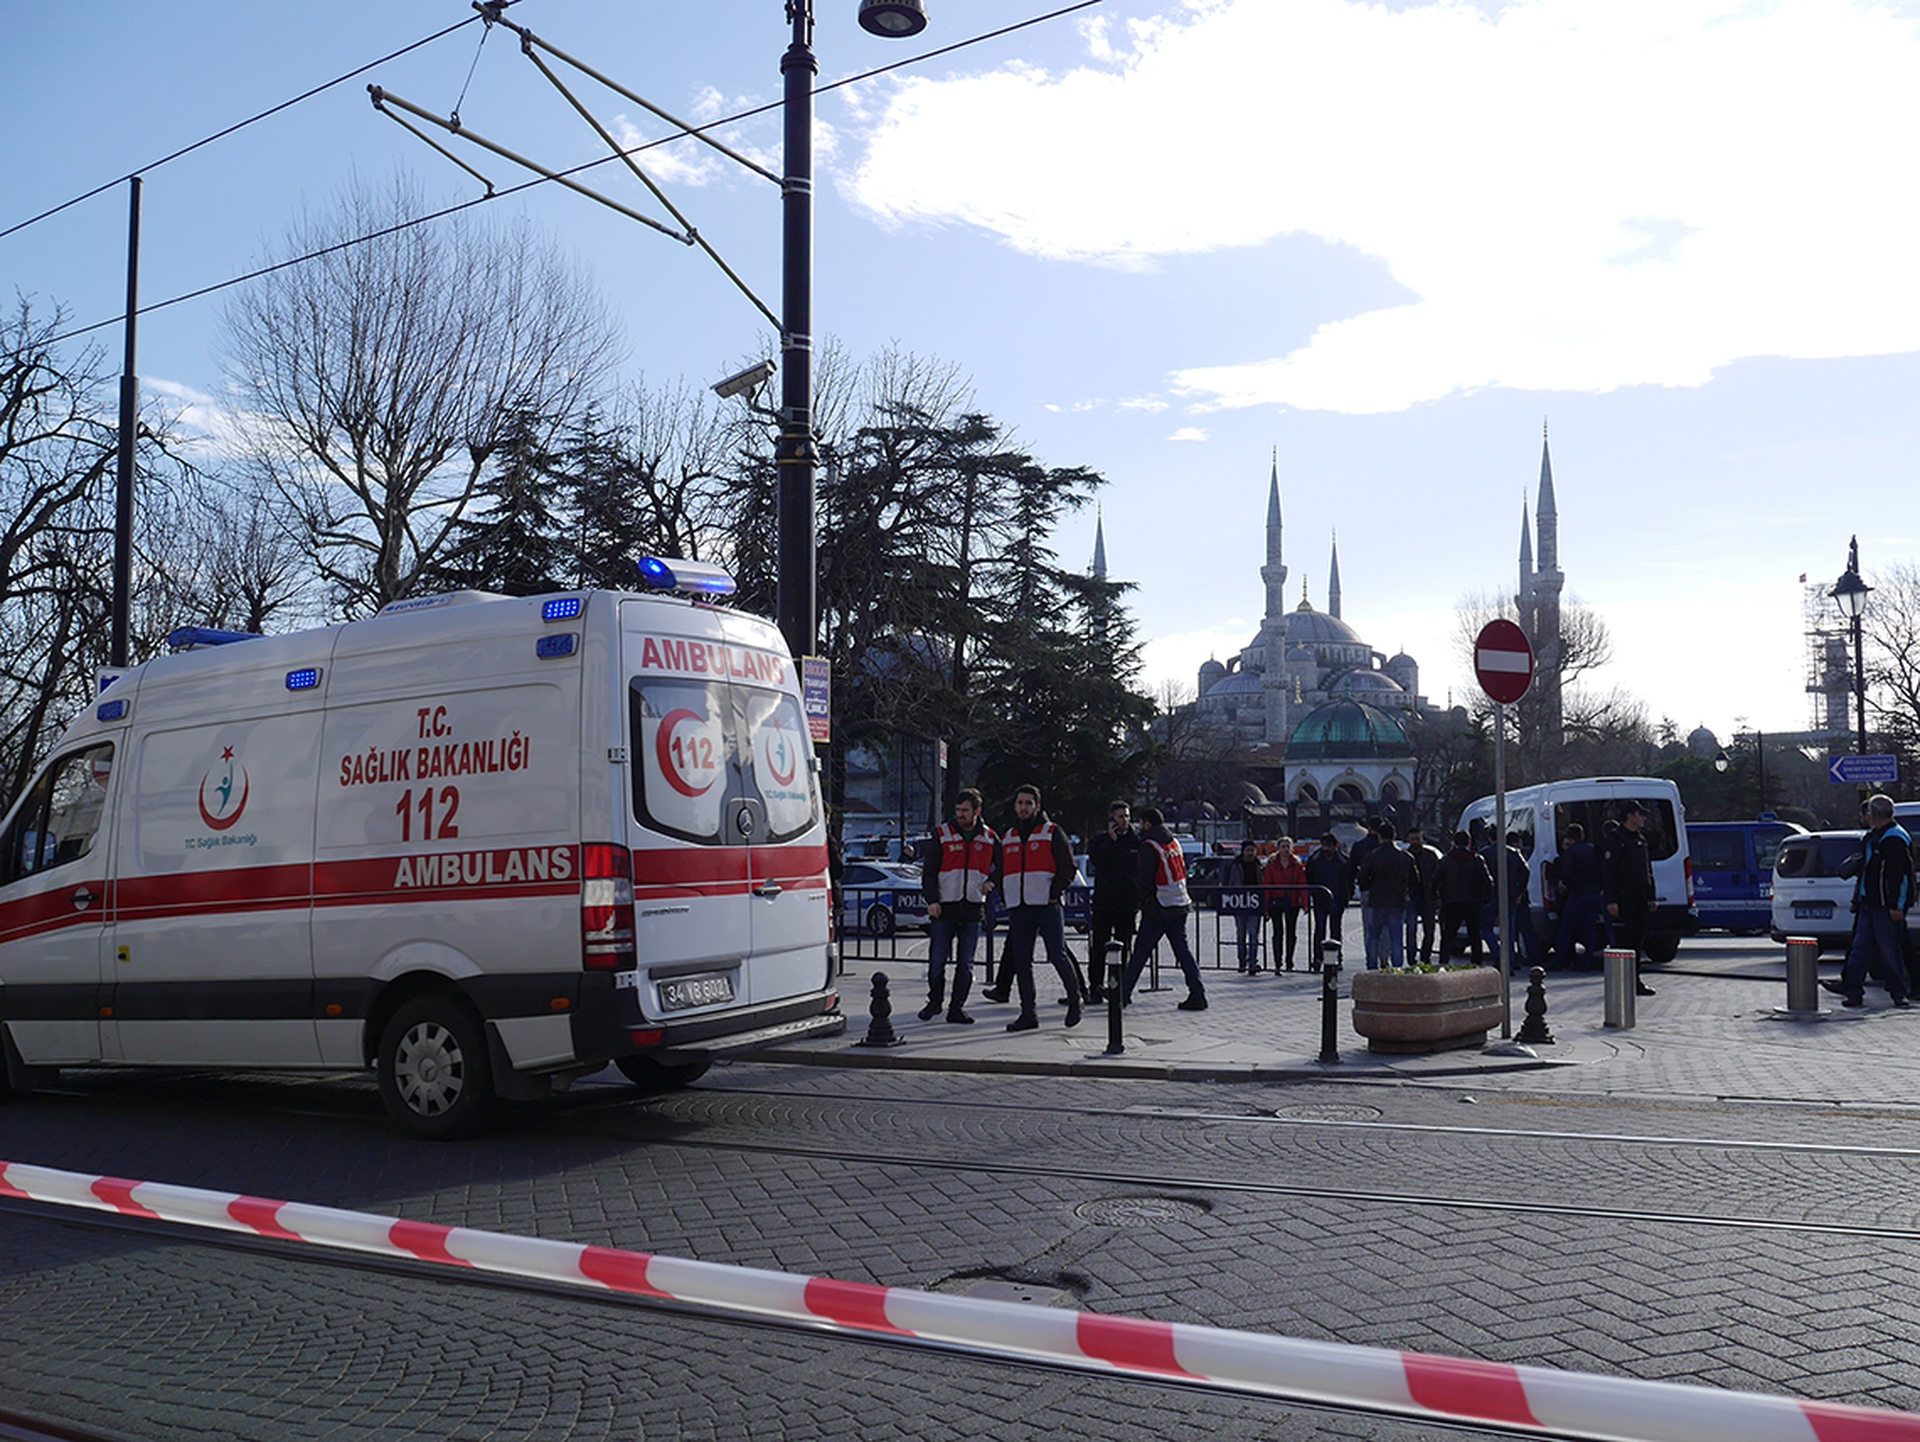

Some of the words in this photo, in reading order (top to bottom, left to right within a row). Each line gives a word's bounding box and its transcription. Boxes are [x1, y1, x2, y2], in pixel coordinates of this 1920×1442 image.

[641, 637, 786, 685] AMBULANS
[417, 705, 452, 739] T.C.
[340, 746, 411, 786] SAĞLIK
[416, 730, 530, 780] BAKANLIĞI
[672, 736, 715, 769] 112
[396, 785, 460, 842] 112
[394, 847, 572, 888] AMBULANS
[1222, 891, 1260, 909] POLİS
